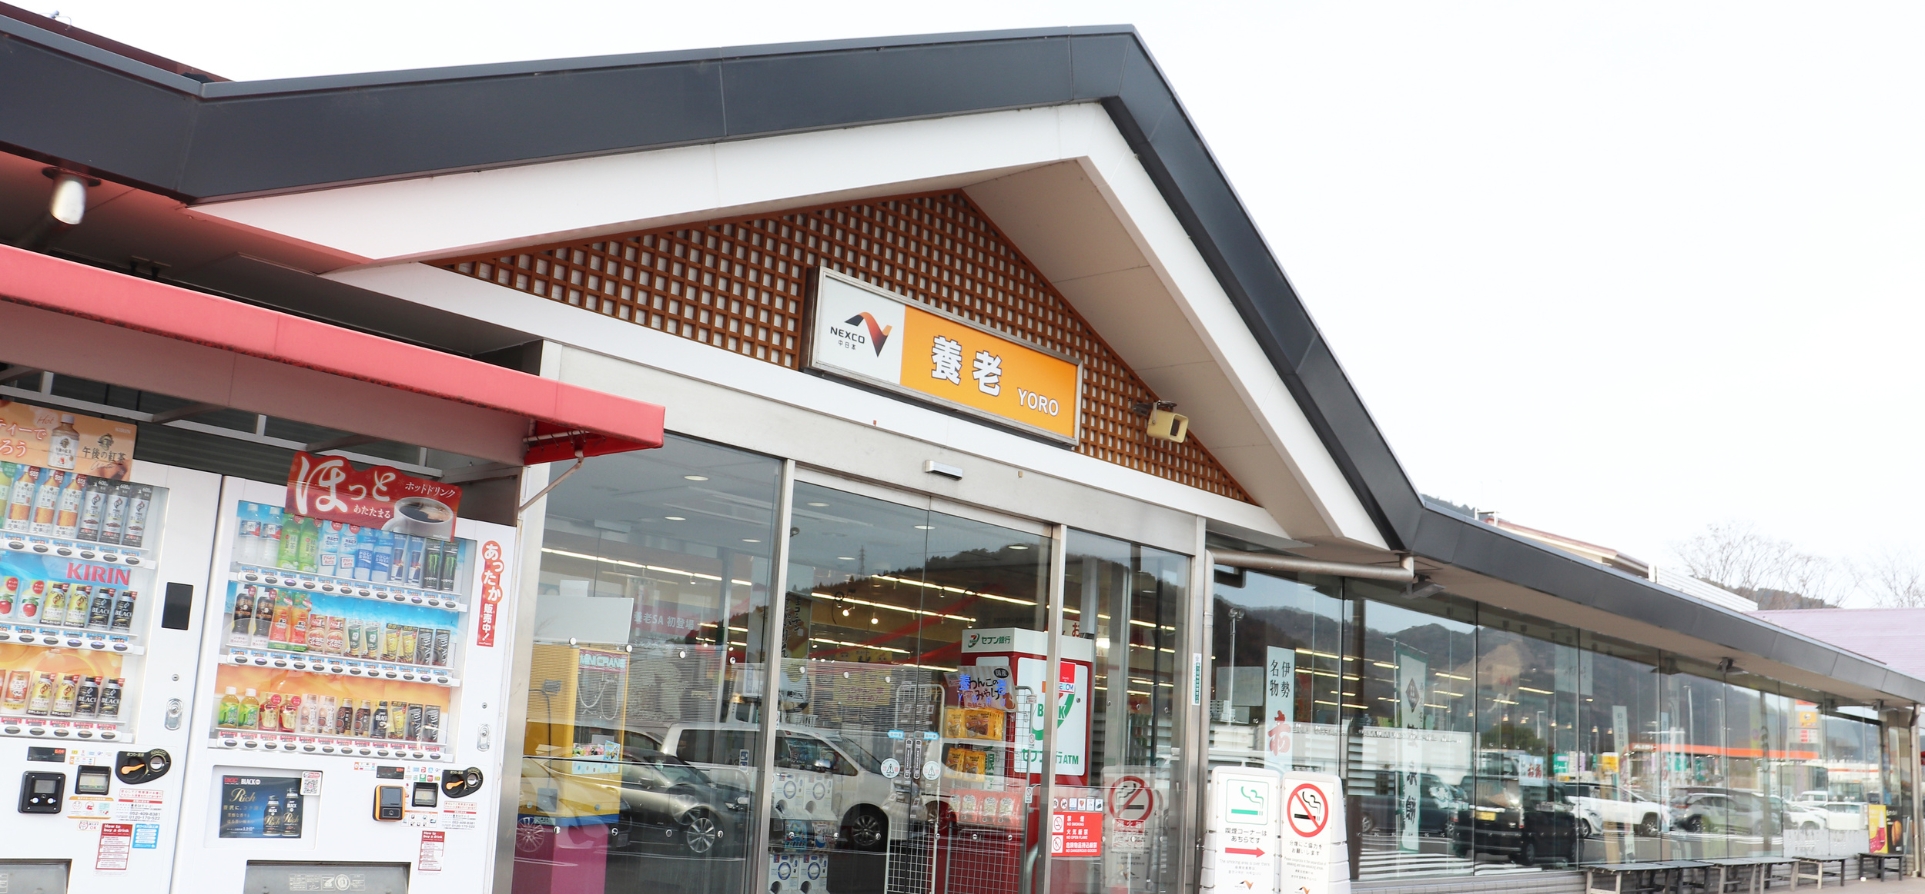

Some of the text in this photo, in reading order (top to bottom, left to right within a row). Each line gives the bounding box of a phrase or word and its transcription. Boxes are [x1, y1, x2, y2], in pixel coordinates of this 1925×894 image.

[830, 325, 865, 344] NEXCO
[837, 339, 857, 351] 中日本
[931, 334, 1003, 397] 養老
[1017, 387, 1059, 417] YORO
[82, 445, 127, 462] 午後の紅茶
[296, 456, 396, 515] ほっと
[404, 481, 456, 499] ホットドリンク
[353, 504, 391, 519] あたたまる
[65, 561, 131, 586] KIRIN
[667, 616, 695, 630] 初登場
[981, 635, 1011, 645] セブン銀行
[229, 787, 256, 802] Rich
[1225, 827, 1267, 836] 喫煙コーナーは
[1231, 836, 1260, 844] あちらです
[1291, 848, 1320, 856] お願いします
